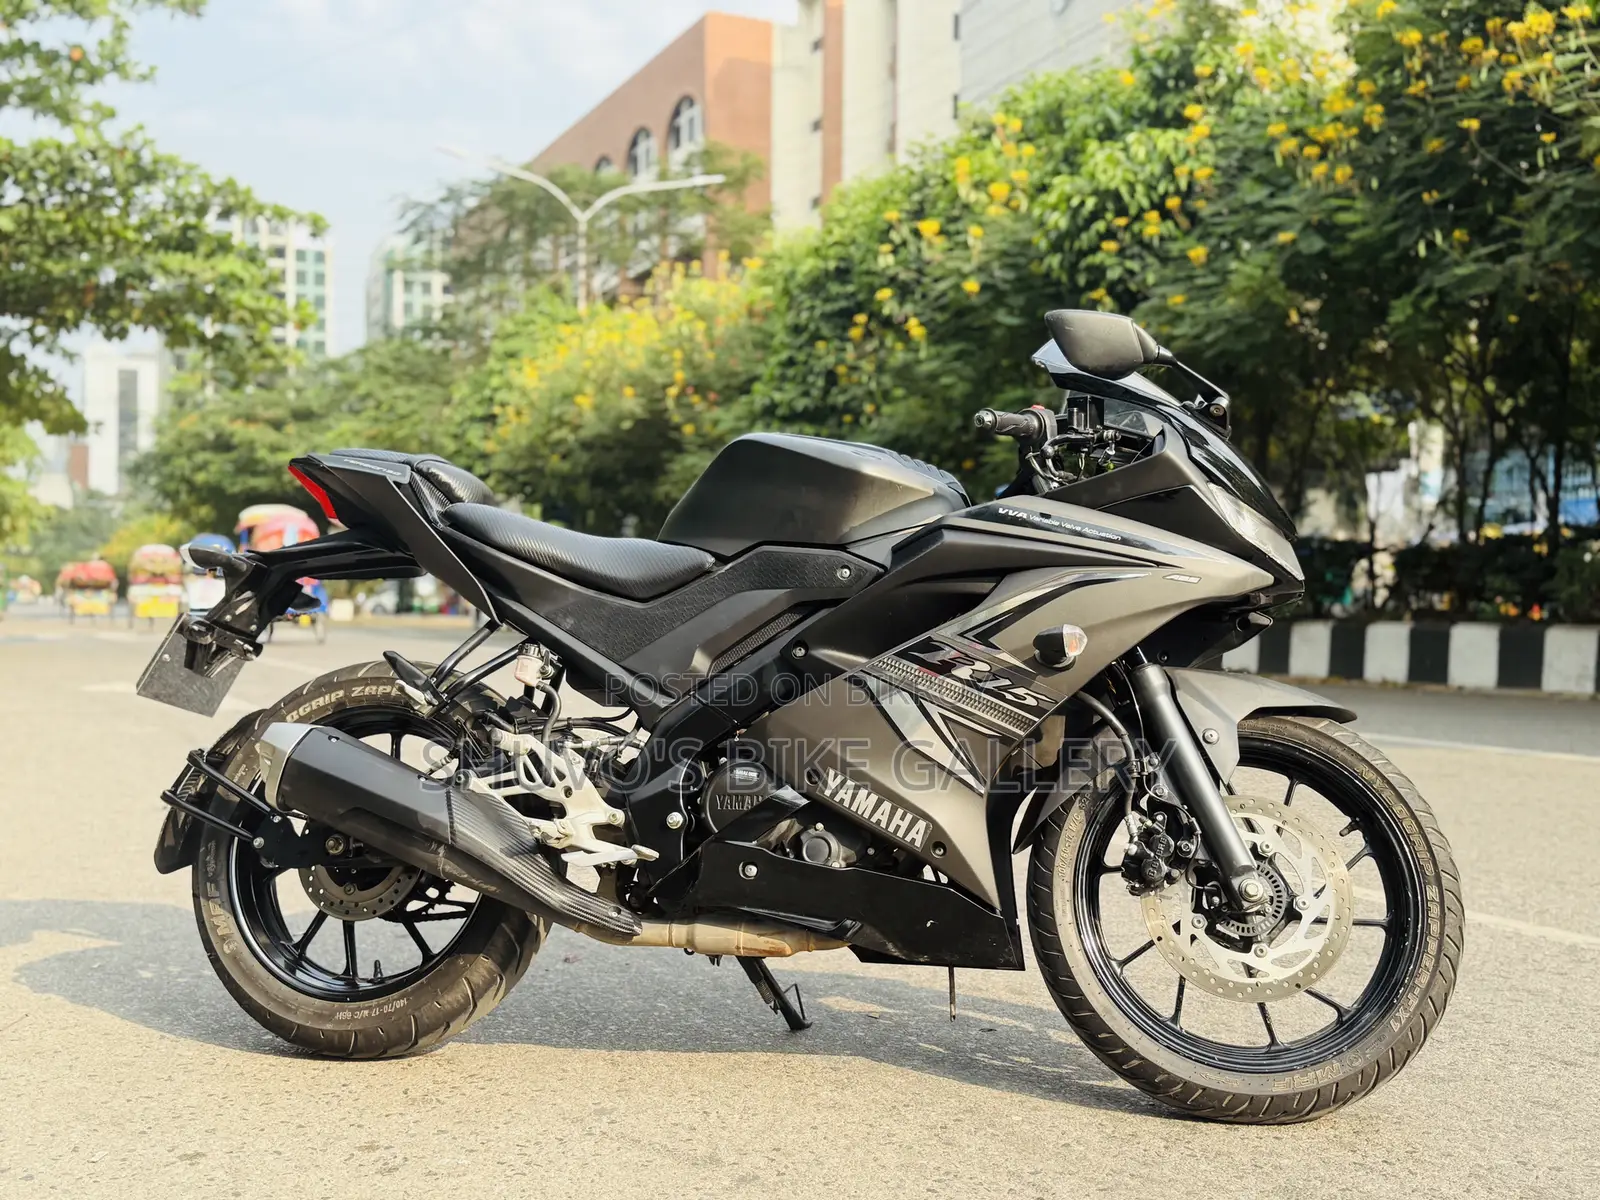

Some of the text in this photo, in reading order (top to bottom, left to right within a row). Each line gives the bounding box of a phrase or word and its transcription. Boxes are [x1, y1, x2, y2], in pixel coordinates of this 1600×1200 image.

[998, 507, 1121, 541] VVA Variable Valve Actuation
[908, 641, 1058, 708] R15
[285, 684, 401, 723] OGRIP ZAPP
[715, 794, 768, 811] YAMAH
[823, 768, 927, 848] YAMAHA
[206, 880, 233, 937] MRF
[1271, 1060, 1343, 1092] MRF
